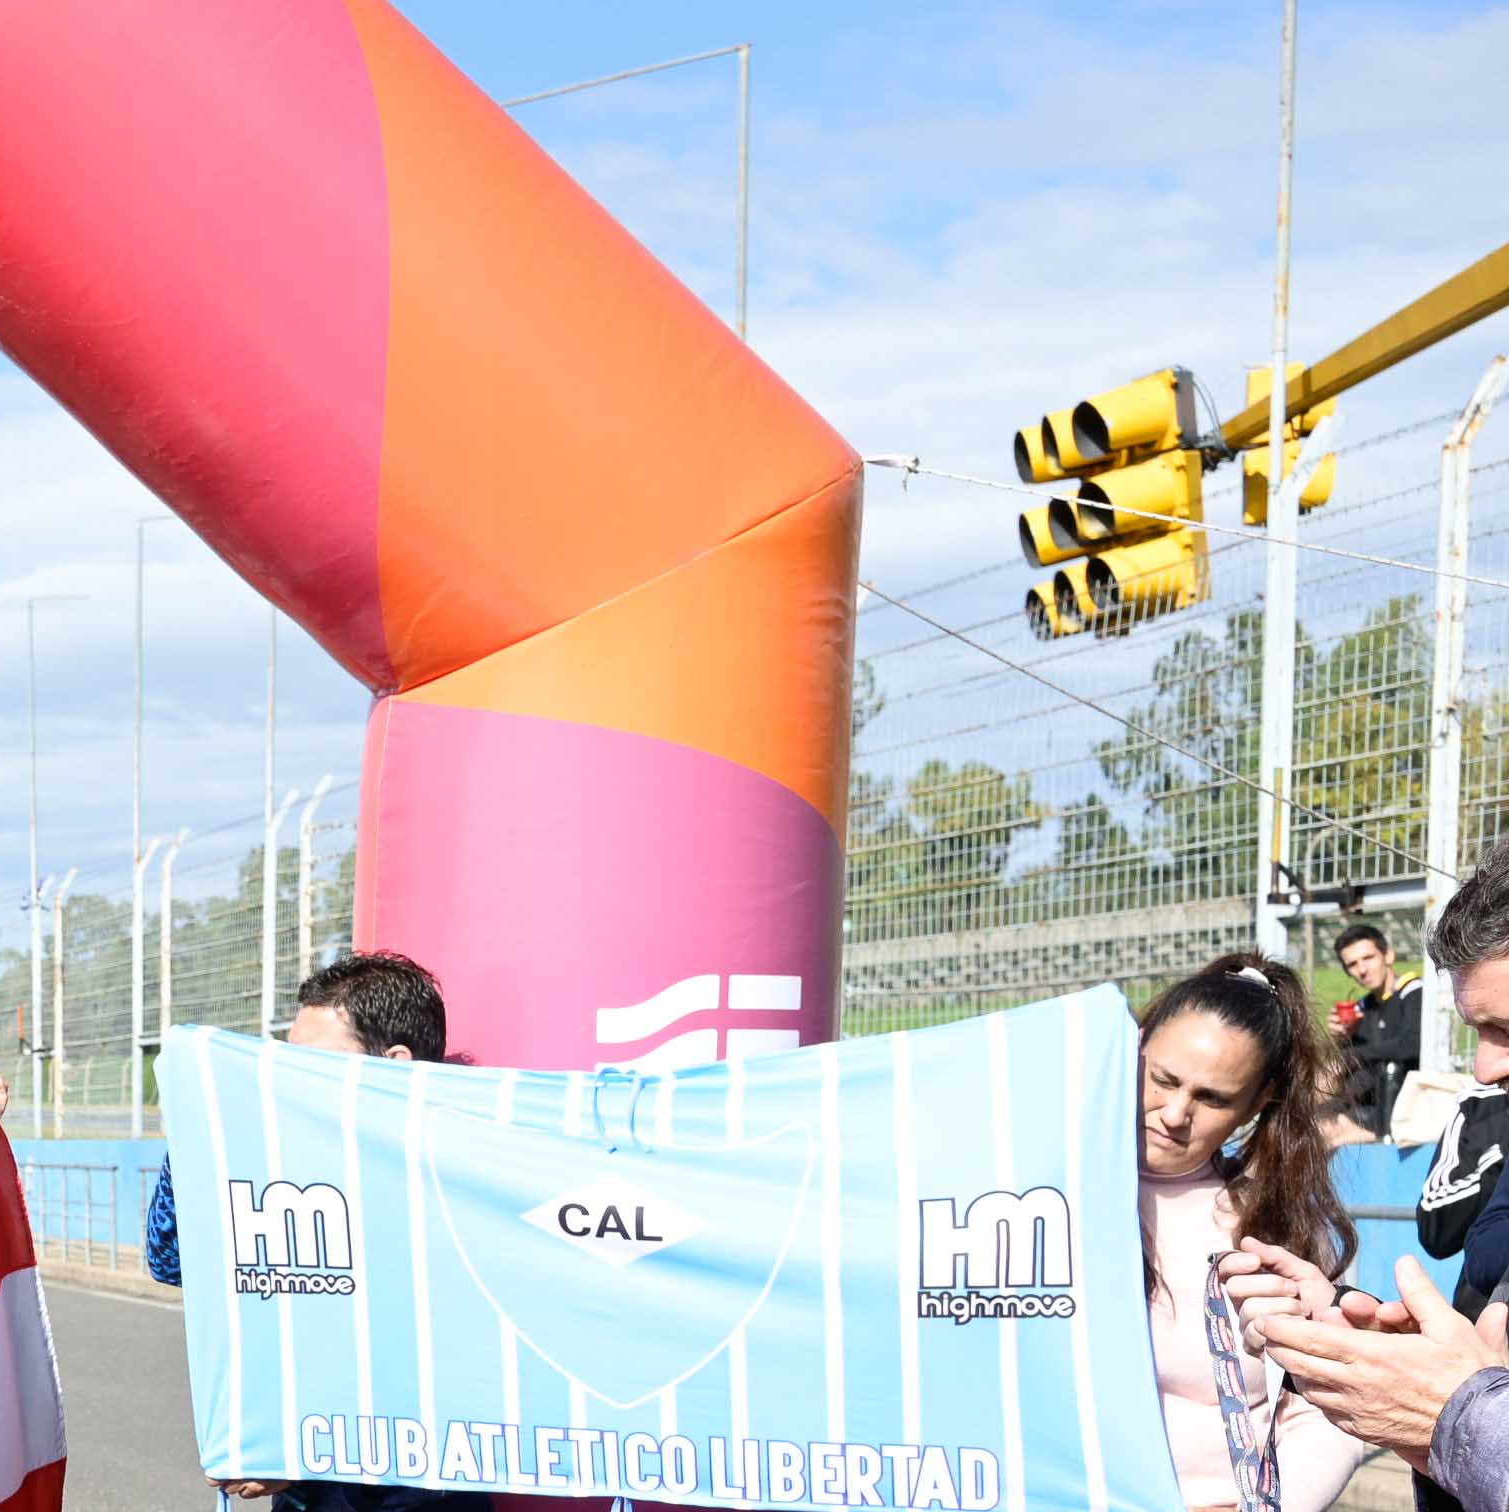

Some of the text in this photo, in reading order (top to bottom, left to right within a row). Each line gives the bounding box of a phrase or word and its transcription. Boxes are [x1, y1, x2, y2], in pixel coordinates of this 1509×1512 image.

[557, 1203, 663, 1242] CAL
[235, 1268, 355, 1300] highmove
[918, 1291, 1076, 1325] highmove
[300, 1413, 1001, 1512] CLUB ATLETICO LIBERTAD
